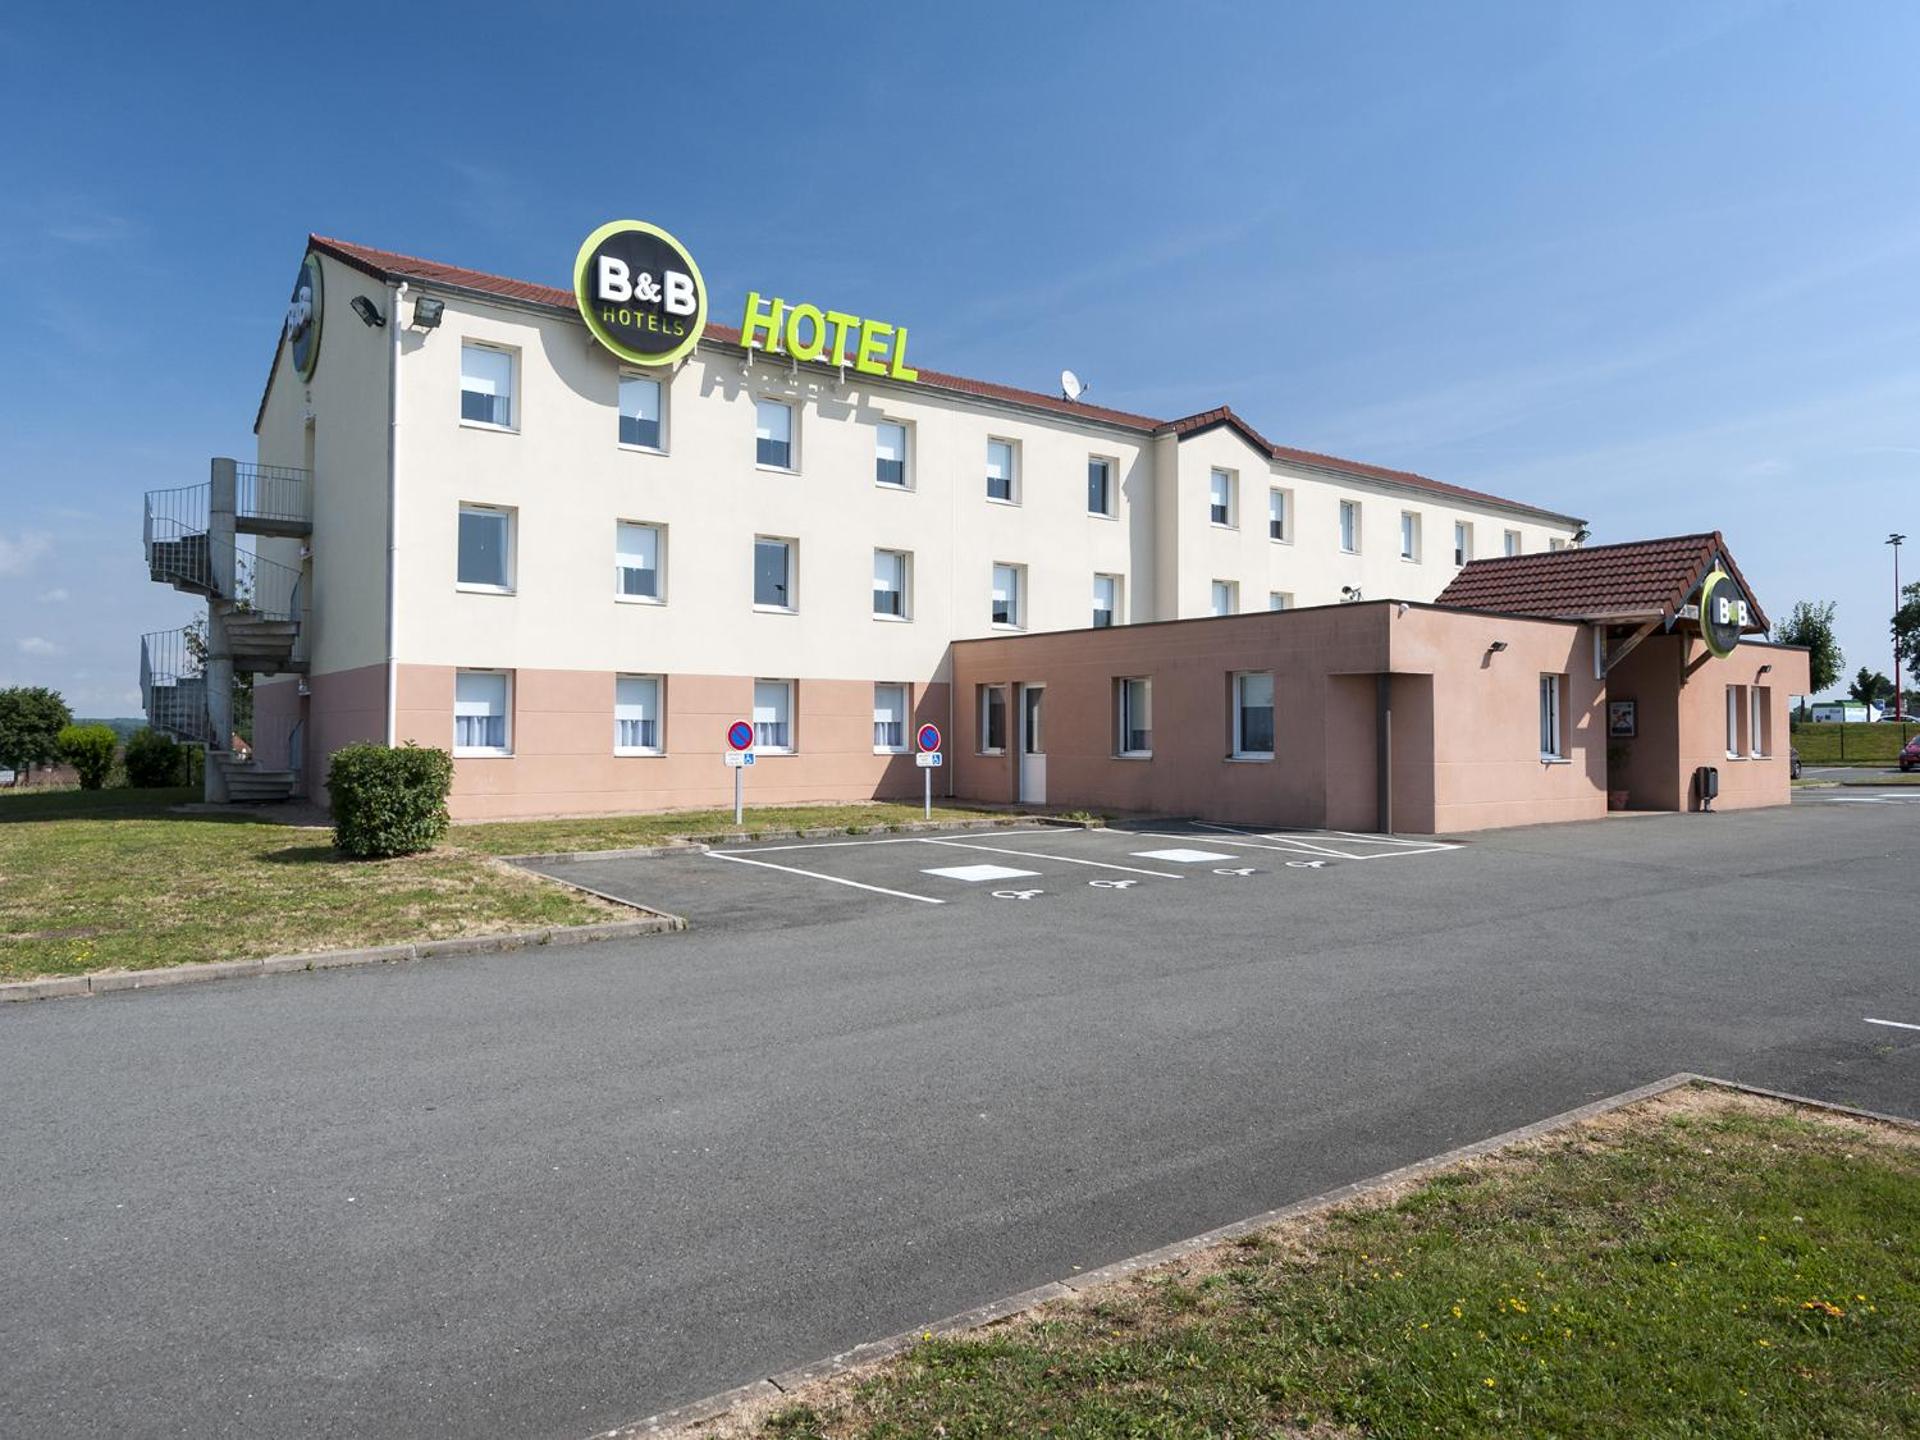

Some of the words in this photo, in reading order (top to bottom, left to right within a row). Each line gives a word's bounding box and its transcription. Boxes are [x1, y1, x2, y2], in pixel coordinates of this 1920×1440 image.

[598, 255, 697, 316] B&B
[603, 306, 684, 336] HOTELS
[740, 291, 918, 382] HOTEL
[1719, 597, 1748, 627] BB
